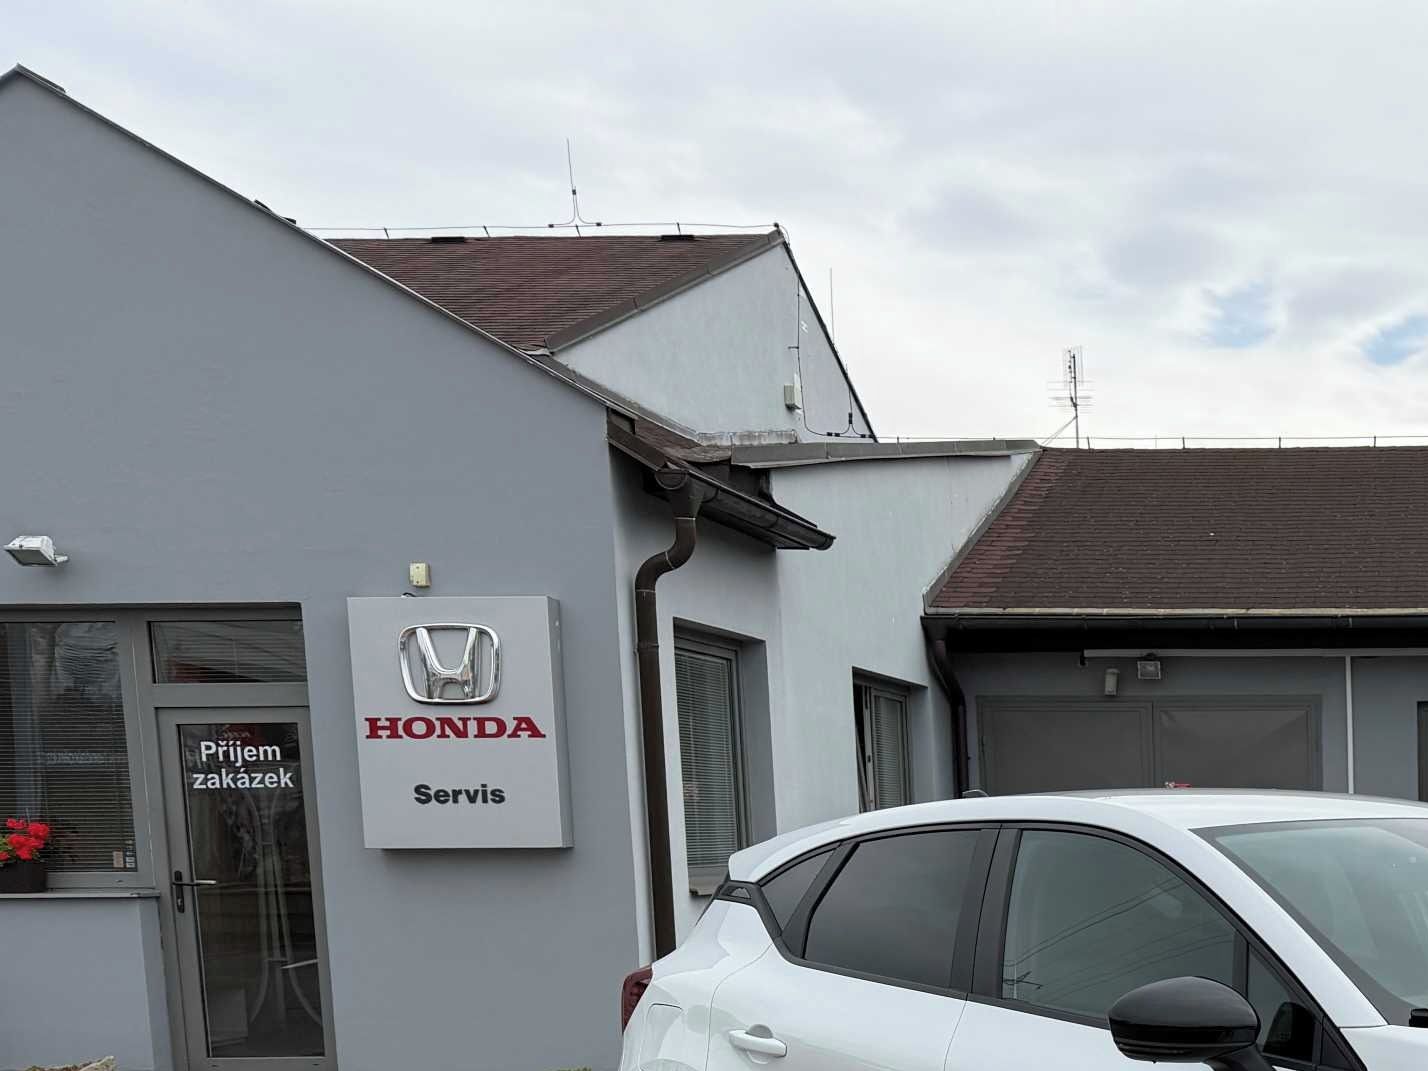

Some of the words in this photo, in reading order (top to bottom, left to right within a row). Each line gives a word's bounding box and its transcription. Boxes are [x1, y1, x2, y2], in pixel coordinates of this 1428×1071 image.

[364, 716, 547, 740] HONDA
[200, 741, 281, 766] Příjem
[192, 768, 294, 789] zakázek
[413, 783, 506, 805] Servis
